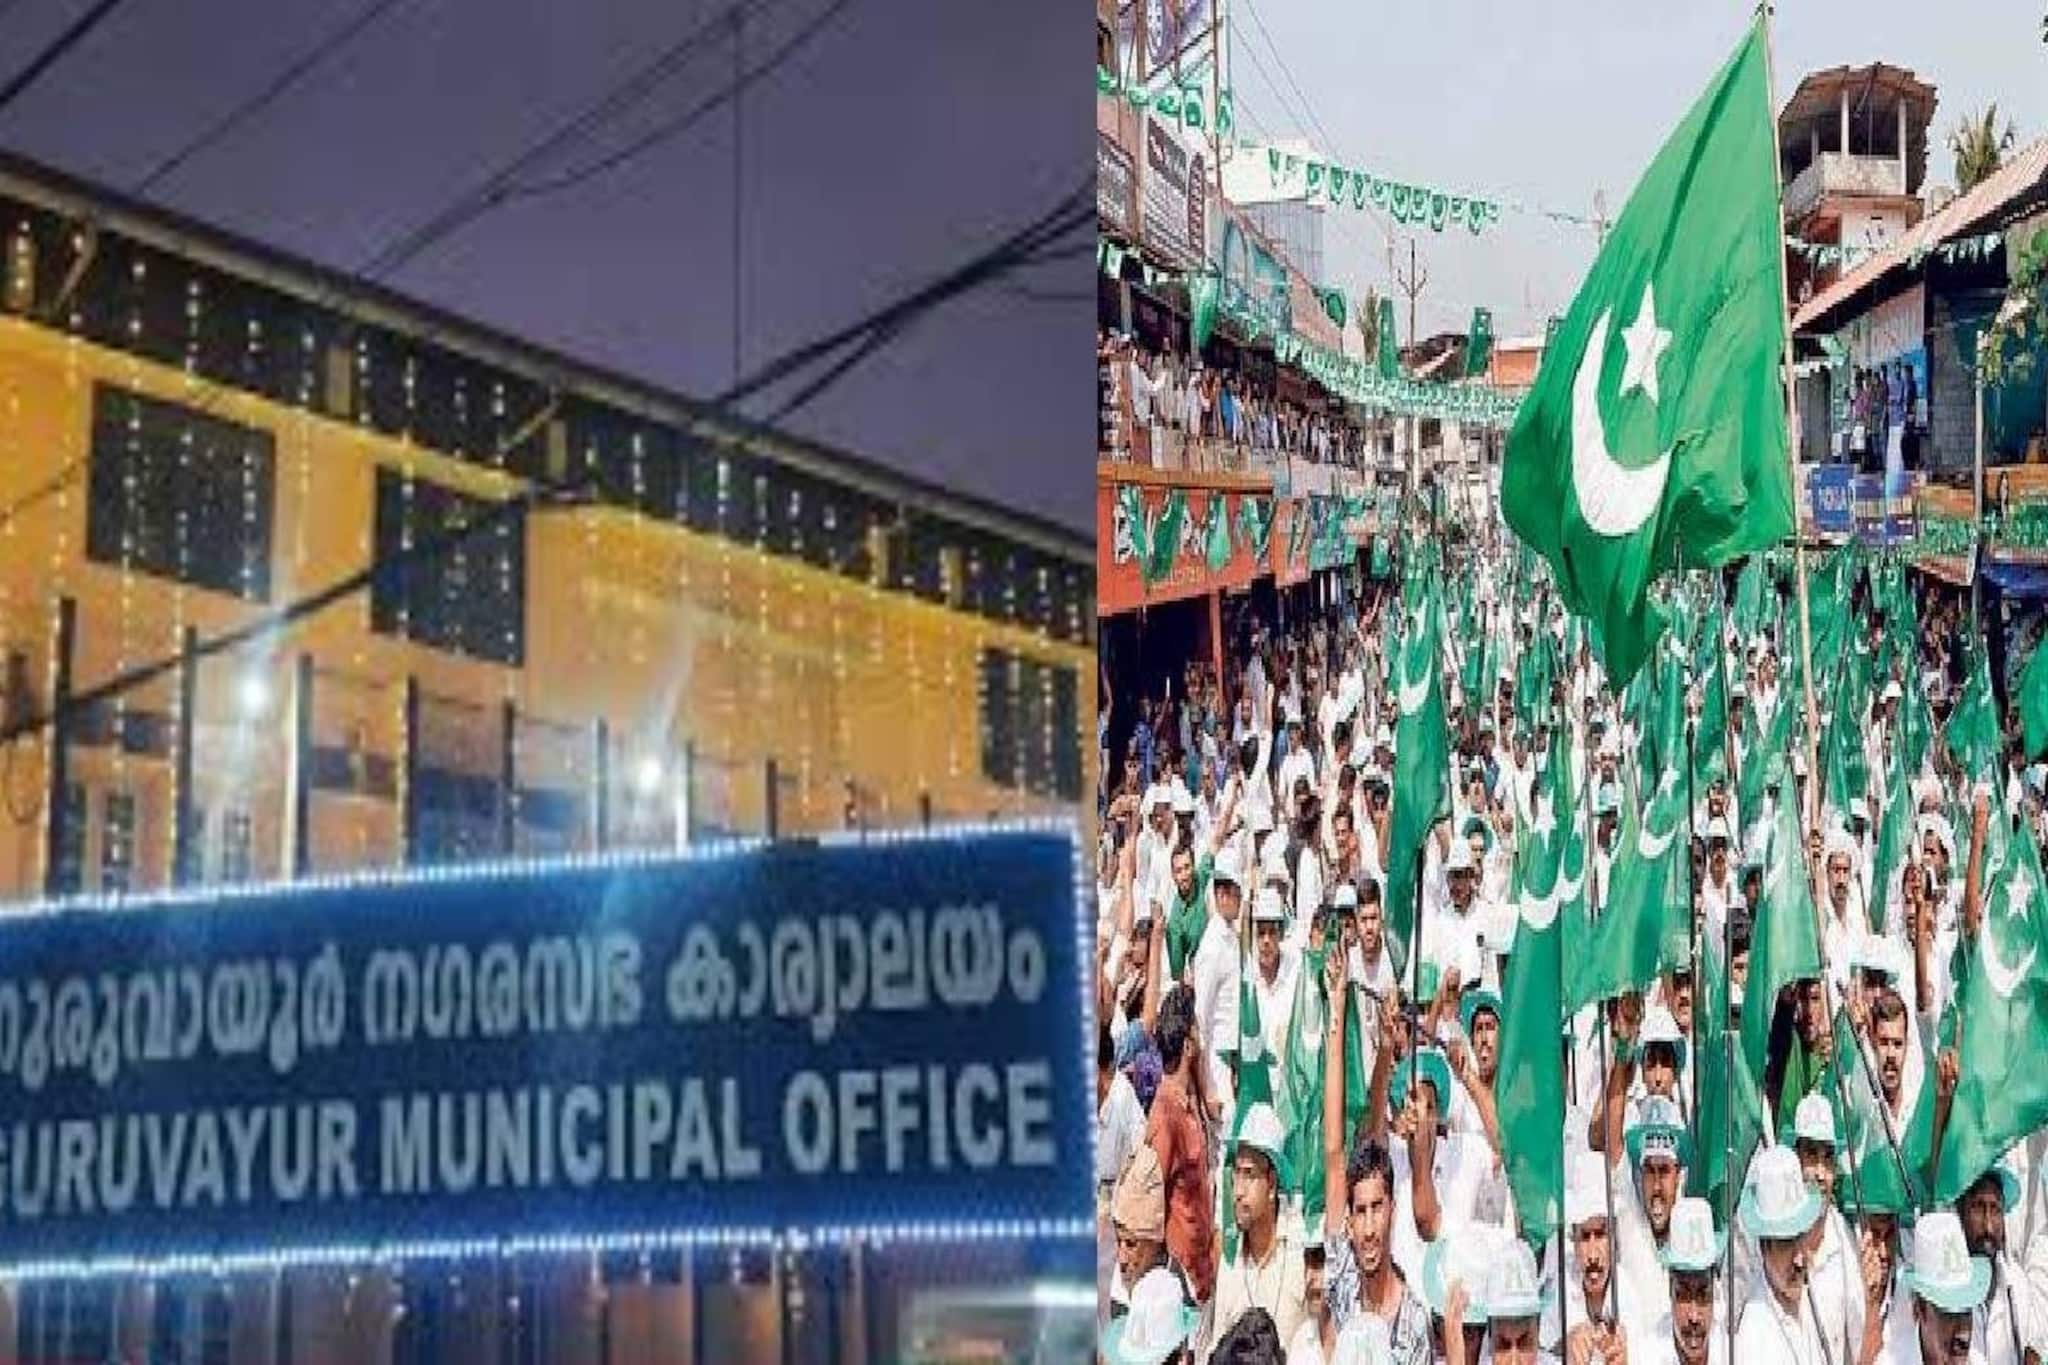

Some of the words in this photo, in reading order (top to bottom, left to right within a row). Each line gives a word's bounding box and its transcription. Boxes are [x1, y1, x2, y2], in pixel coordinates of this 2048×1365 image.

[364, 932, 643, 1046] നഗരസഭ
[667, 902, 1047, 1044] കാര്യാലയം
[0, 1098, 358, 1216] URUVAYUR
[380, 1077, 762, 1194] MUNICIPAL
[782, 1060, 1057, 1175] OFFICE
